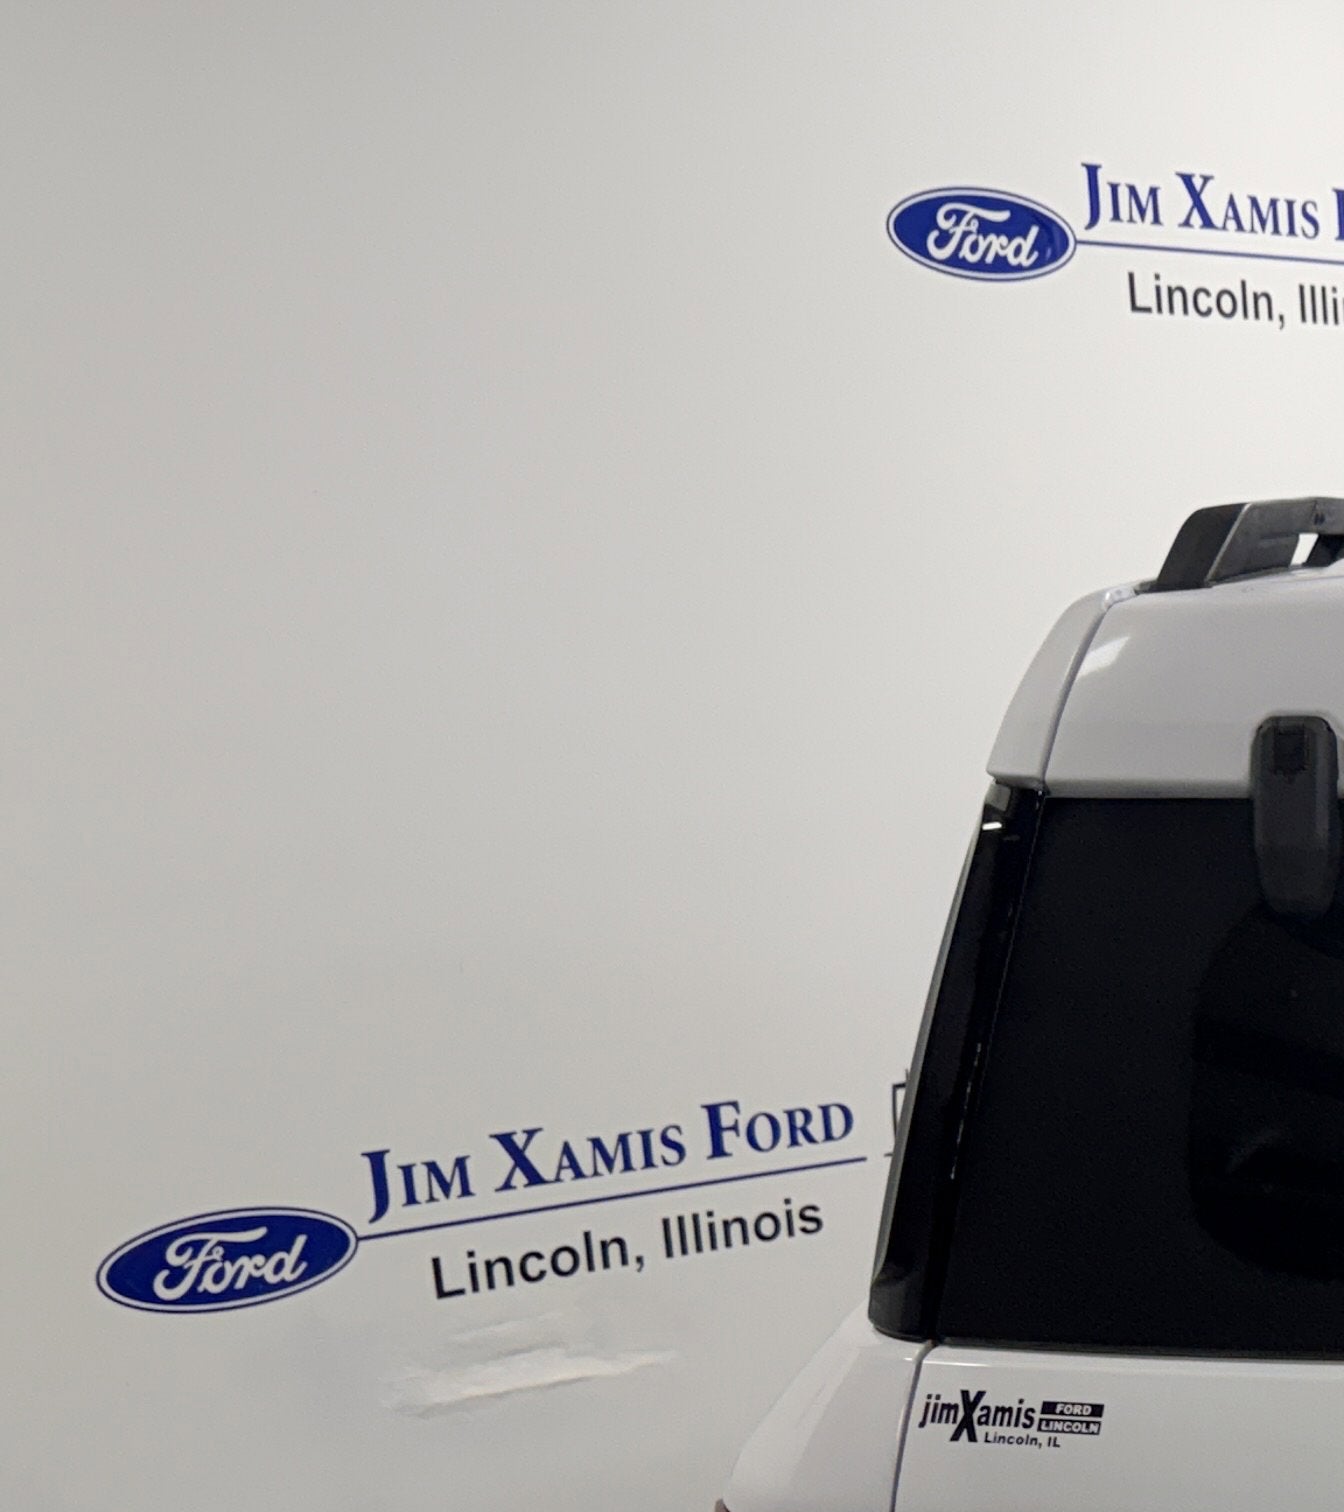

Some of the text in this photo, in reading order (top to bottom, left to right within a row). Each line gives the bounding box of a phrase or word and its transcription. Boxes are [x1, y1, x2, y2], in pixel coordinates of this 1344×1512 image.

[1081, 163, 1163, 230] JIM
[1176, 172, 1320, 240] XAMIS
[926, 203, 1040, 268] Ford
[1127, 272, 1286, 329] Lincoln,
[361, 1100, 854, 1224] JIM XAMIS FORD
[153, 1226, 308, 1301] Ford
[430, 1199, 824, 1300] Lincoln, Illinois
[984, 1432, 1060, 1449] Lincoln, IL
[1040, 1420, 1099, 1433] LINCOLN
[1055, 1404, 1092, 1415] FORD
